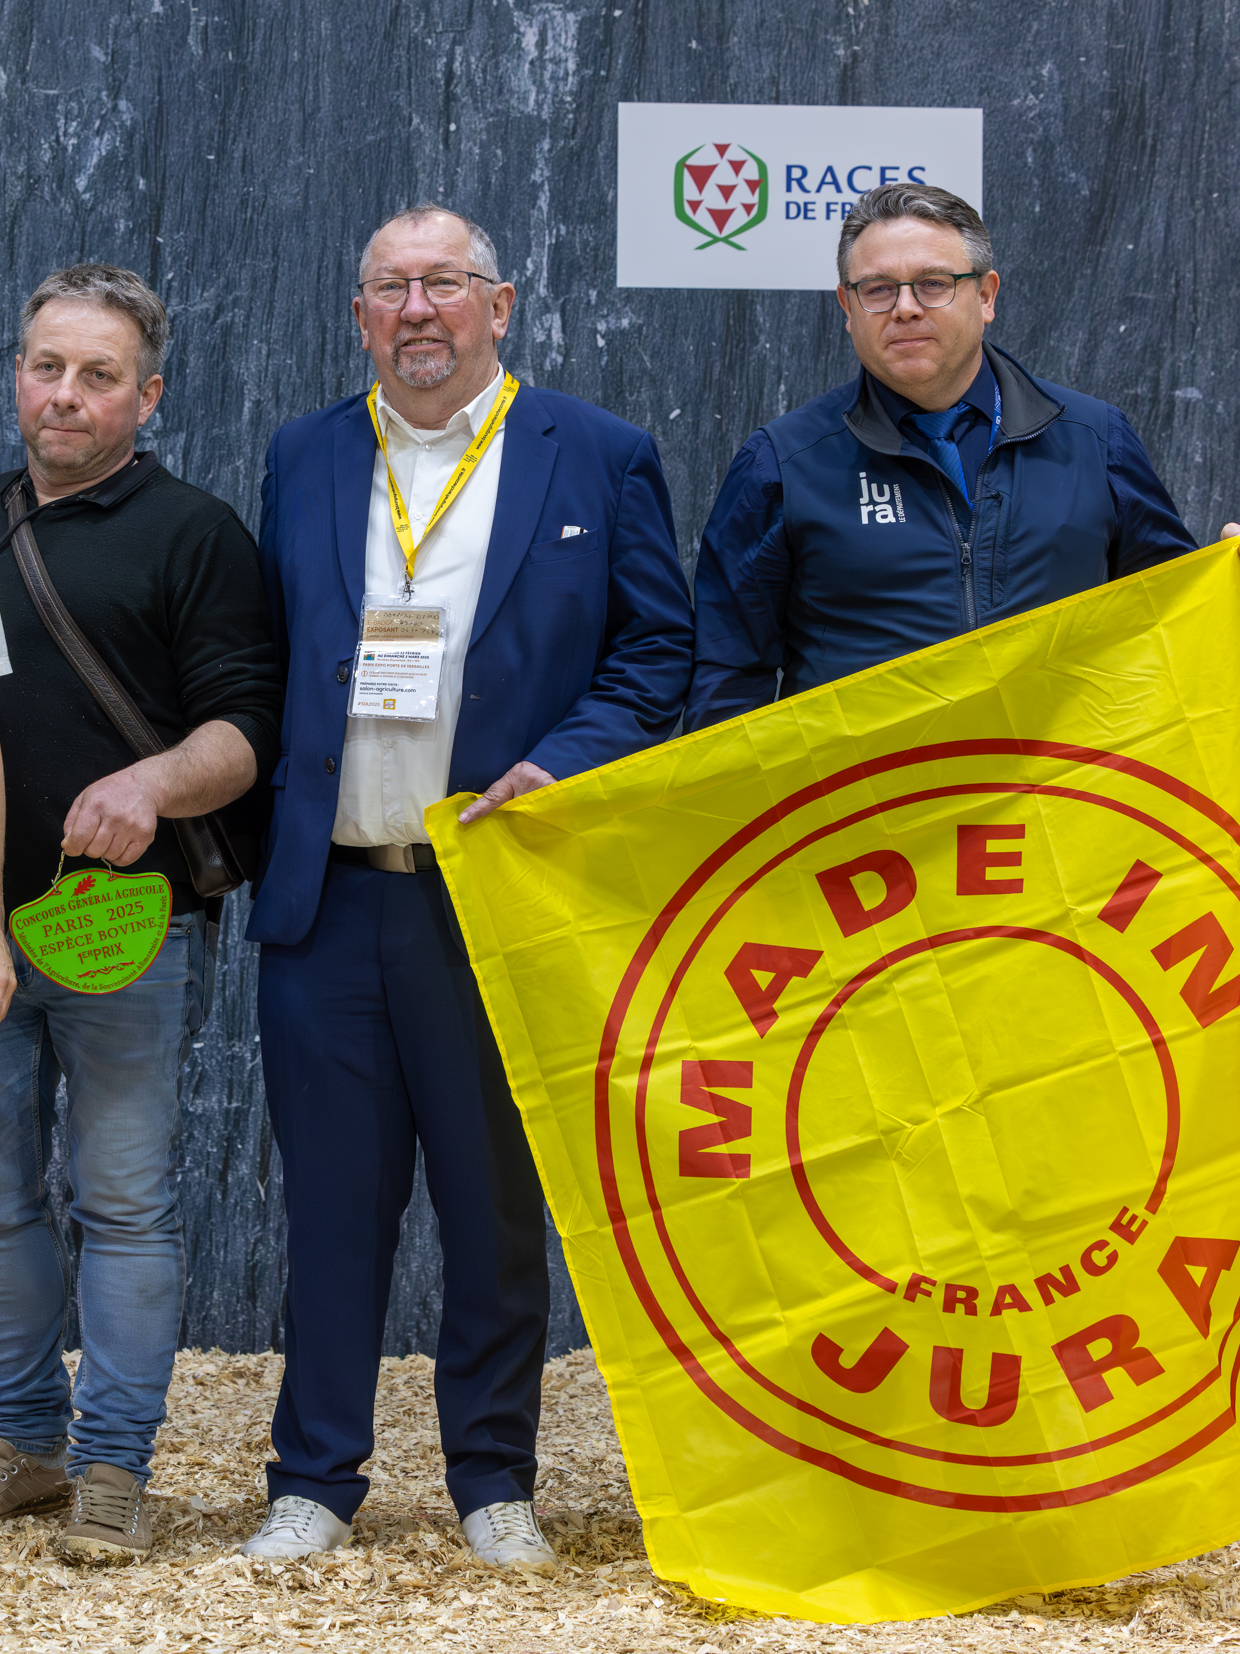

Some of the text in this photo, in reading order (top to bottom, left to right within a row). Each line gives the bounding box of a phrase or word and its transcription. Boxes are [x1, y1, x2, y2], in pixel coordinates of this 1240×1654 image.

[785, 164, 927, 194] RACES
[785, 201, 817, 221] DE
[15, 883, 165, 931] CONCOURS GÉNÉRAL AGRICOLE
[41, 900, 144, 938] PARIS 2025
[17, 931, 38, 959] Ministère
[36, 958, 44, 966] de
[83, 982, 90, 990] de
[99, 968, 138, 990] Souveraineté
[136, 937, 160, 971] Alimentaire
[157, 920, 165, 930] de
[38, 916, 157, 957] ESPÈCE BOVINE
[679, 824, 1240, 1179] MADE IN
[903, 1205, 1149, 1317] FRANCE
[811, 1235, 1240, 1427] JURA
